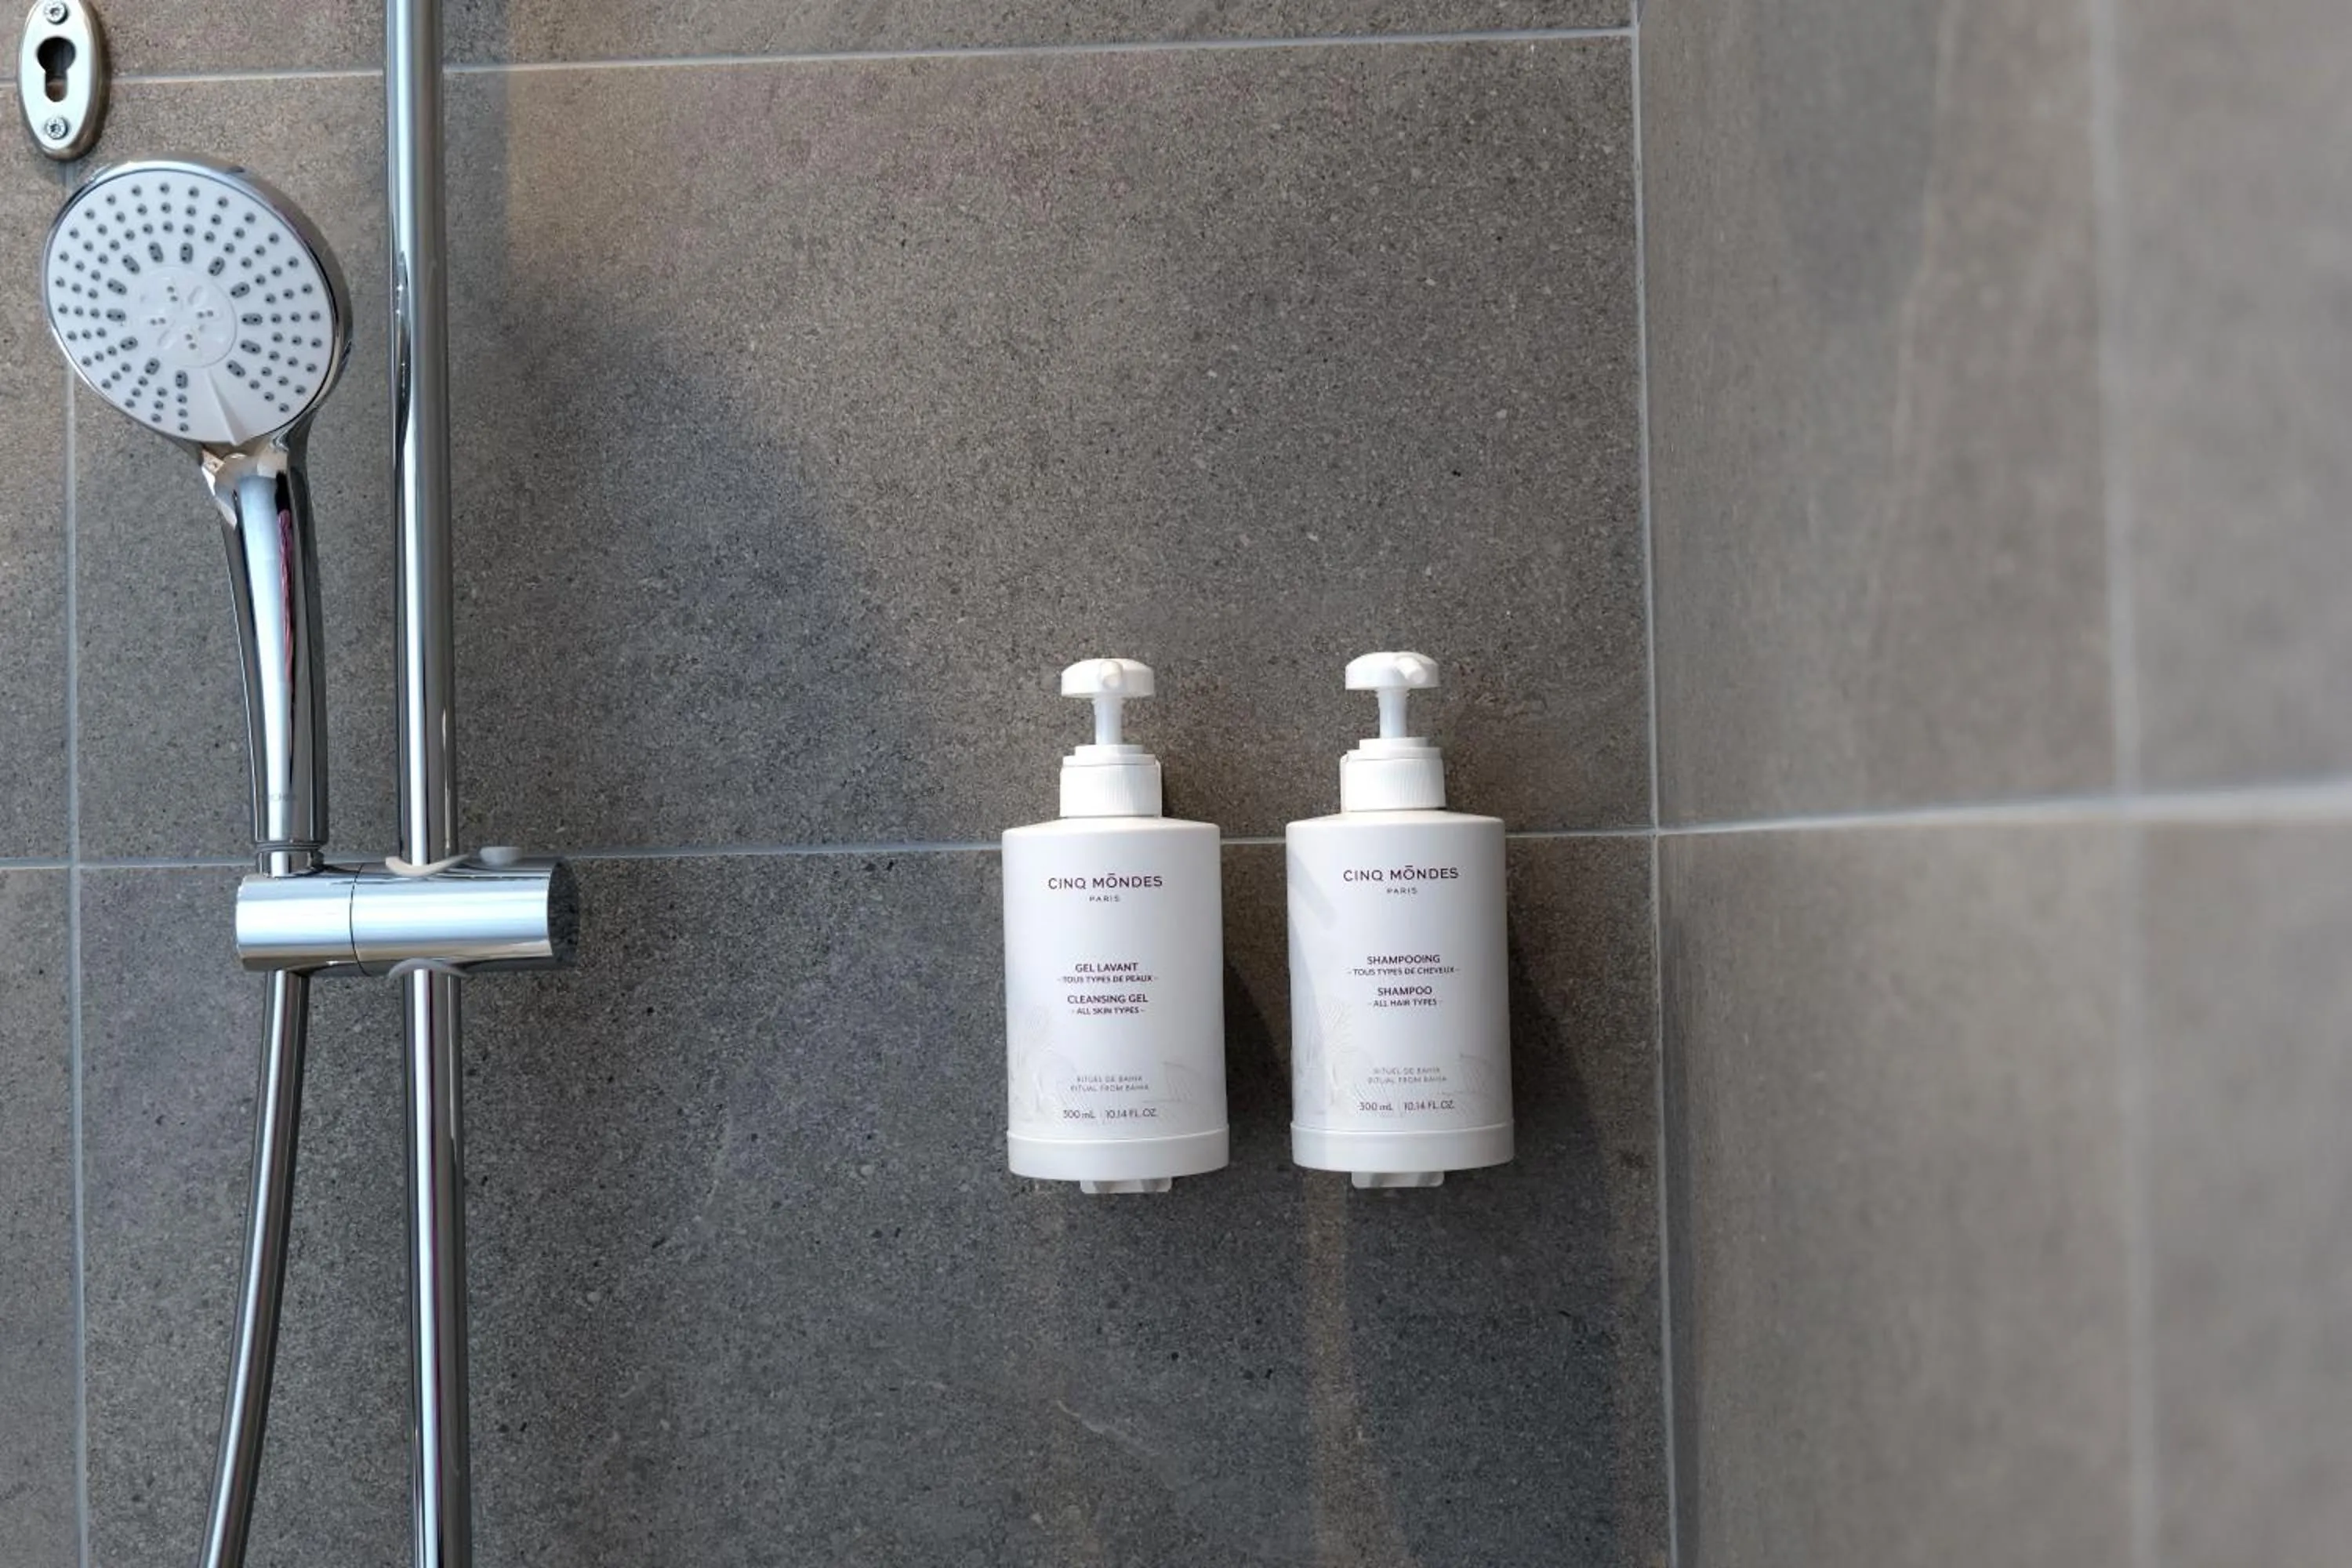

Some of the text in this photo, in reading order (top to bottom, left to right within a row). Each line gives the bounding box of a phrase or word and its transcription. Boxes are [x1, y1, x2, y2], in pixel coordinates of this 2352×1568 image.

[1343, 869, 1384, 881] CINQ
[1048, 877, 1086, 889] CINQ
[1367, 955, 1440, 964] SHAMPOOING
[1075, 962, 1138, 973] GEL LAVANT
[1377, 986, 1432, 996] SHAMPOO
[1067, 994, 1149, 1004] CLEANSING GEL
[1082, 1109, 1095, 1118] mL
